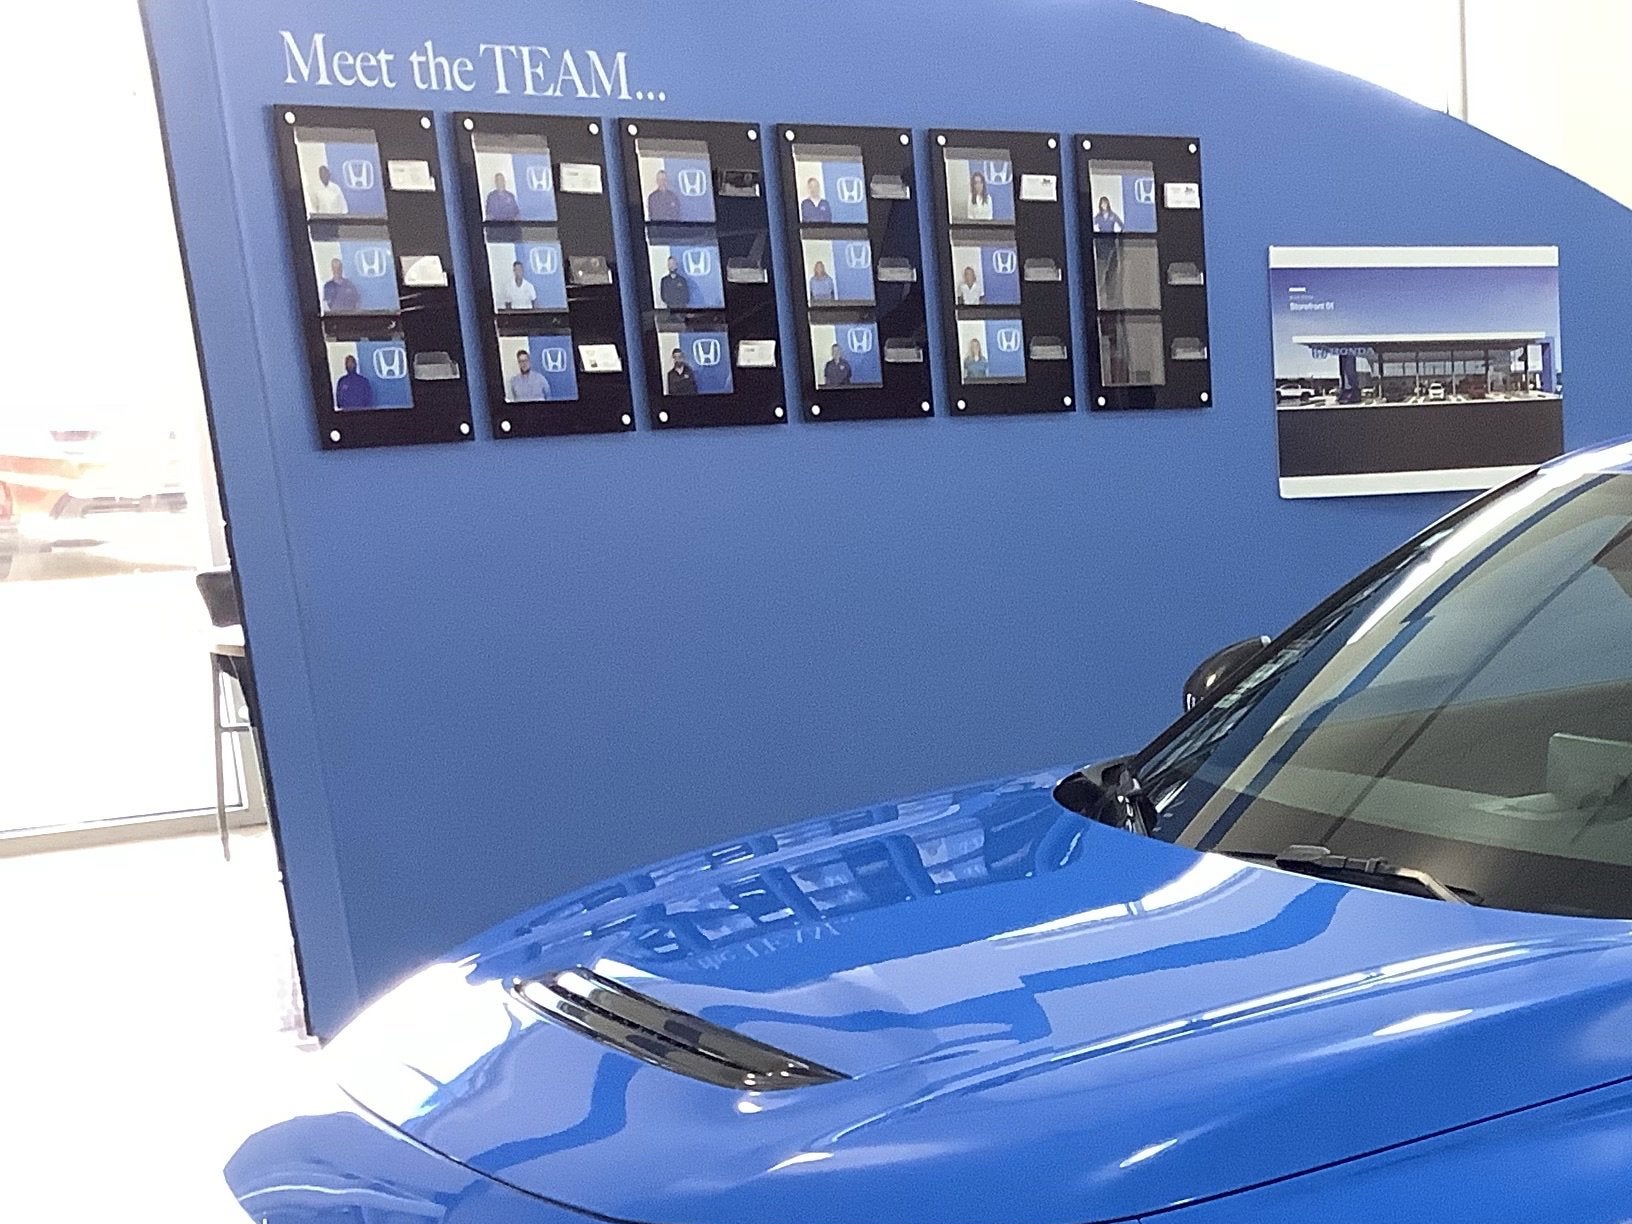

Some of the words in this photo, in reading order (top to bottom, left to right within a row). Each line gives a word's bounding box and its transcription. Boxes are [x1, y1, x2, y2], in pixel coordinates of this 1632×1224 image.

[279, 30, 396, 89] Meet
[409, 40, 476, 92] the
[479, 43, 667, 102] TEAM...
